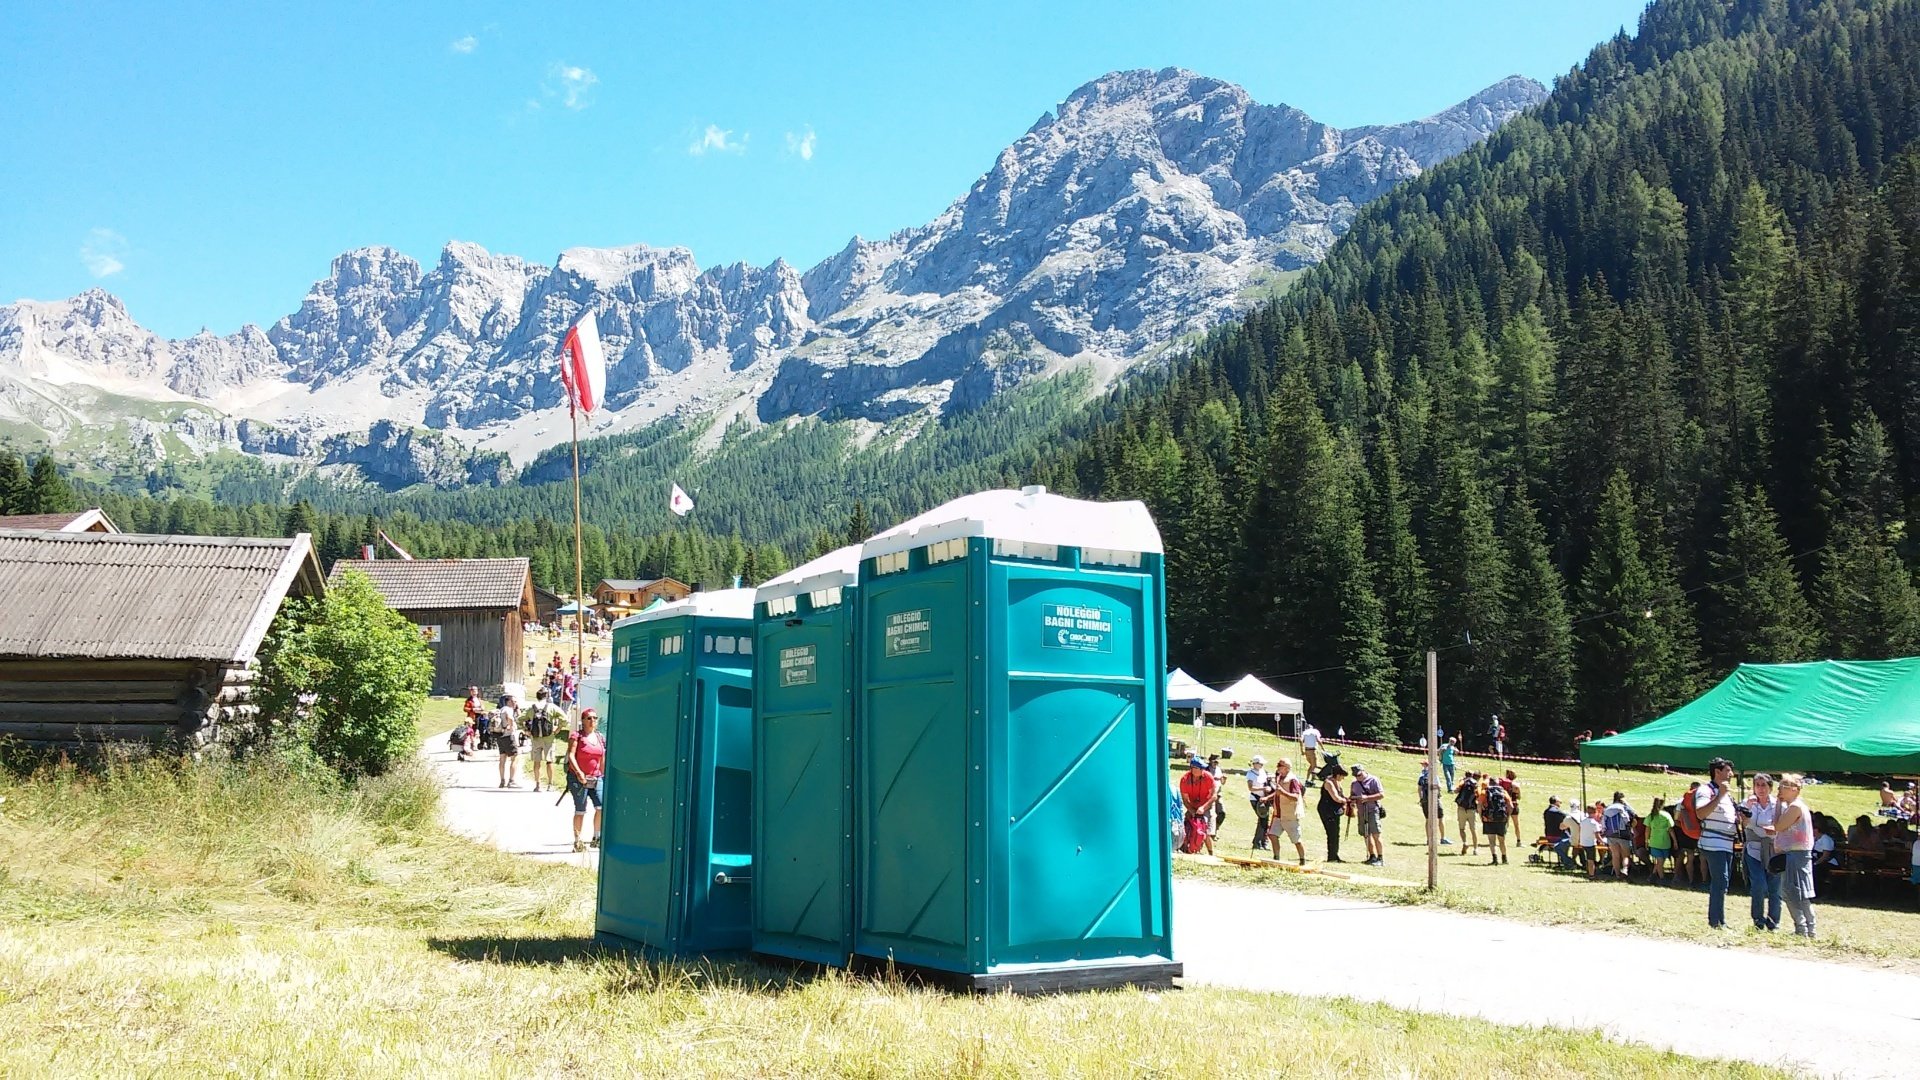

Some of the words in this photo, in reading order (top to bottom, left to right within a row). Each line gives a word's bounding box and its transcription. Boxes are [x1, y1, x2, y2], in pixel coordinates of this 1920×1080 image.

[892, 611, 921, 625] NOLEGGIO
[1056, 606, 1101, 620] NOLEGGIO
[904, 621, 929, 634] CHIMICI
[1044, 616, 1074, 628] BAGNI
[1076, 619, 1111, 633] CHIMICI
